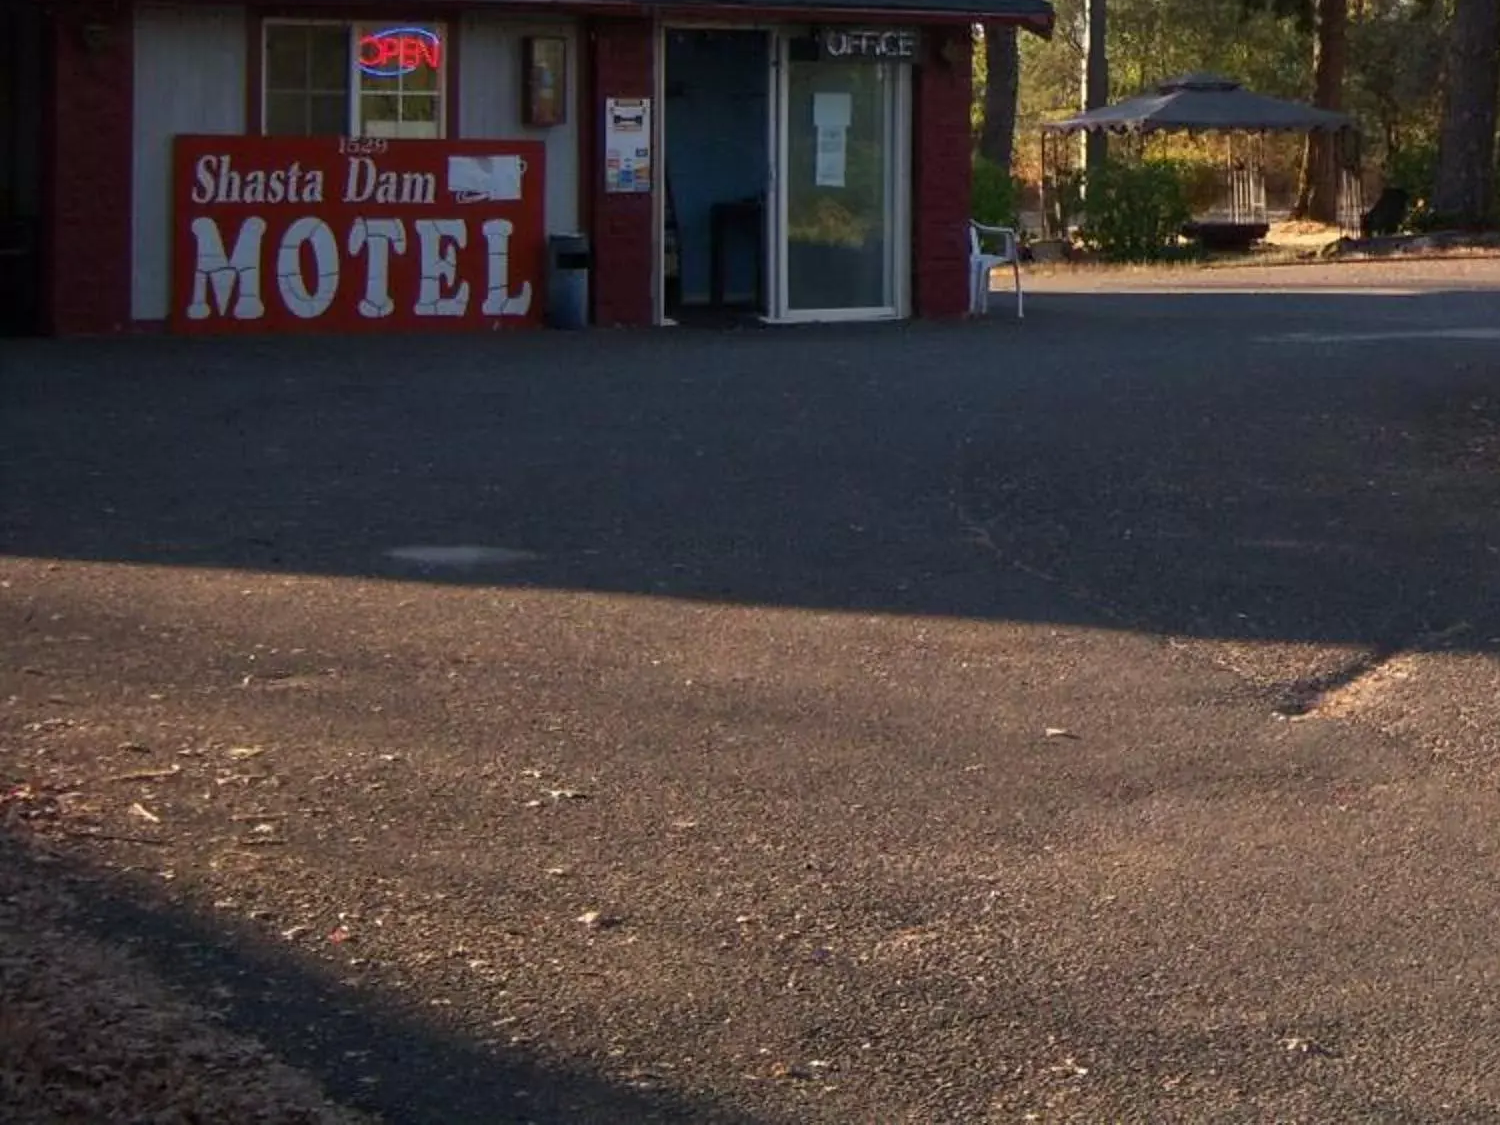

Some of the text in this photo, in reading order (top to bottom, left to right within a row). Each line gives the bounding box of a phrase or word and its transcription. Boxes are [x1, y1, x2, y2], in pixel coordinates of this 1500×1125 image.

[359, 35, 441, 69] OPEN
[826, 30, 914, 57] OFFICE
[192, 154, 436, 203] Shasta Dam
[187, 217, 532, 318] MOTEL
